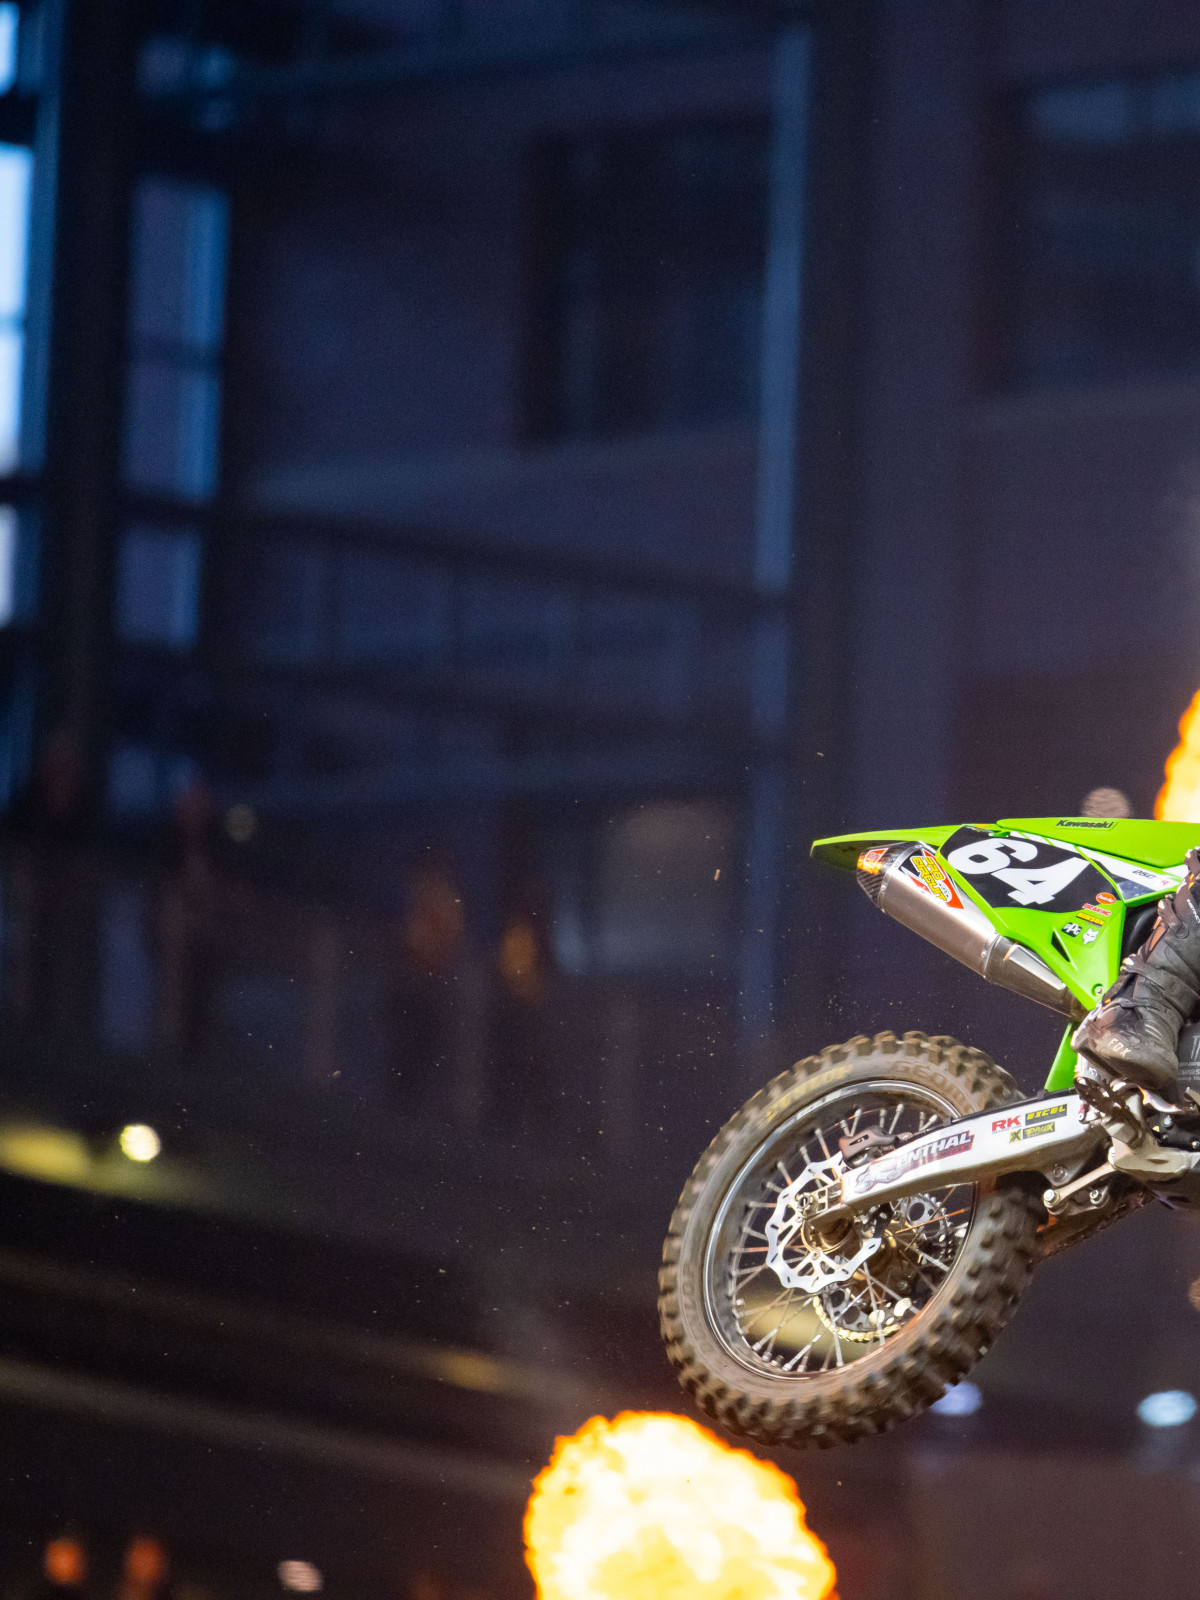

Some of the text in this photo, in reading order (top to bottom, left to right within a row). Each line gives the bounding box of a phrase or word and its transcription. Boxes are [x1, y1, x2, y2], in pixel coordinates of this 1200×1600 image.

[1056, 819, 1114, 829] Kawasaki
[922, 856, 945, 881] PRO
[948, 838, 1090, 906] 64
[1132, 869, 1157, 880] 250
[911, 857, 948, 902] CIRCUIT
[1082, 903, 1112, 916] BRAKING
[1063, 923, 1082, 936] PPG
[1107, 1037, 1133, 1058] FOX
[991, 1115, 1021, 1132] RK
[1026, 1105, 1066, 1121] EXCEL
